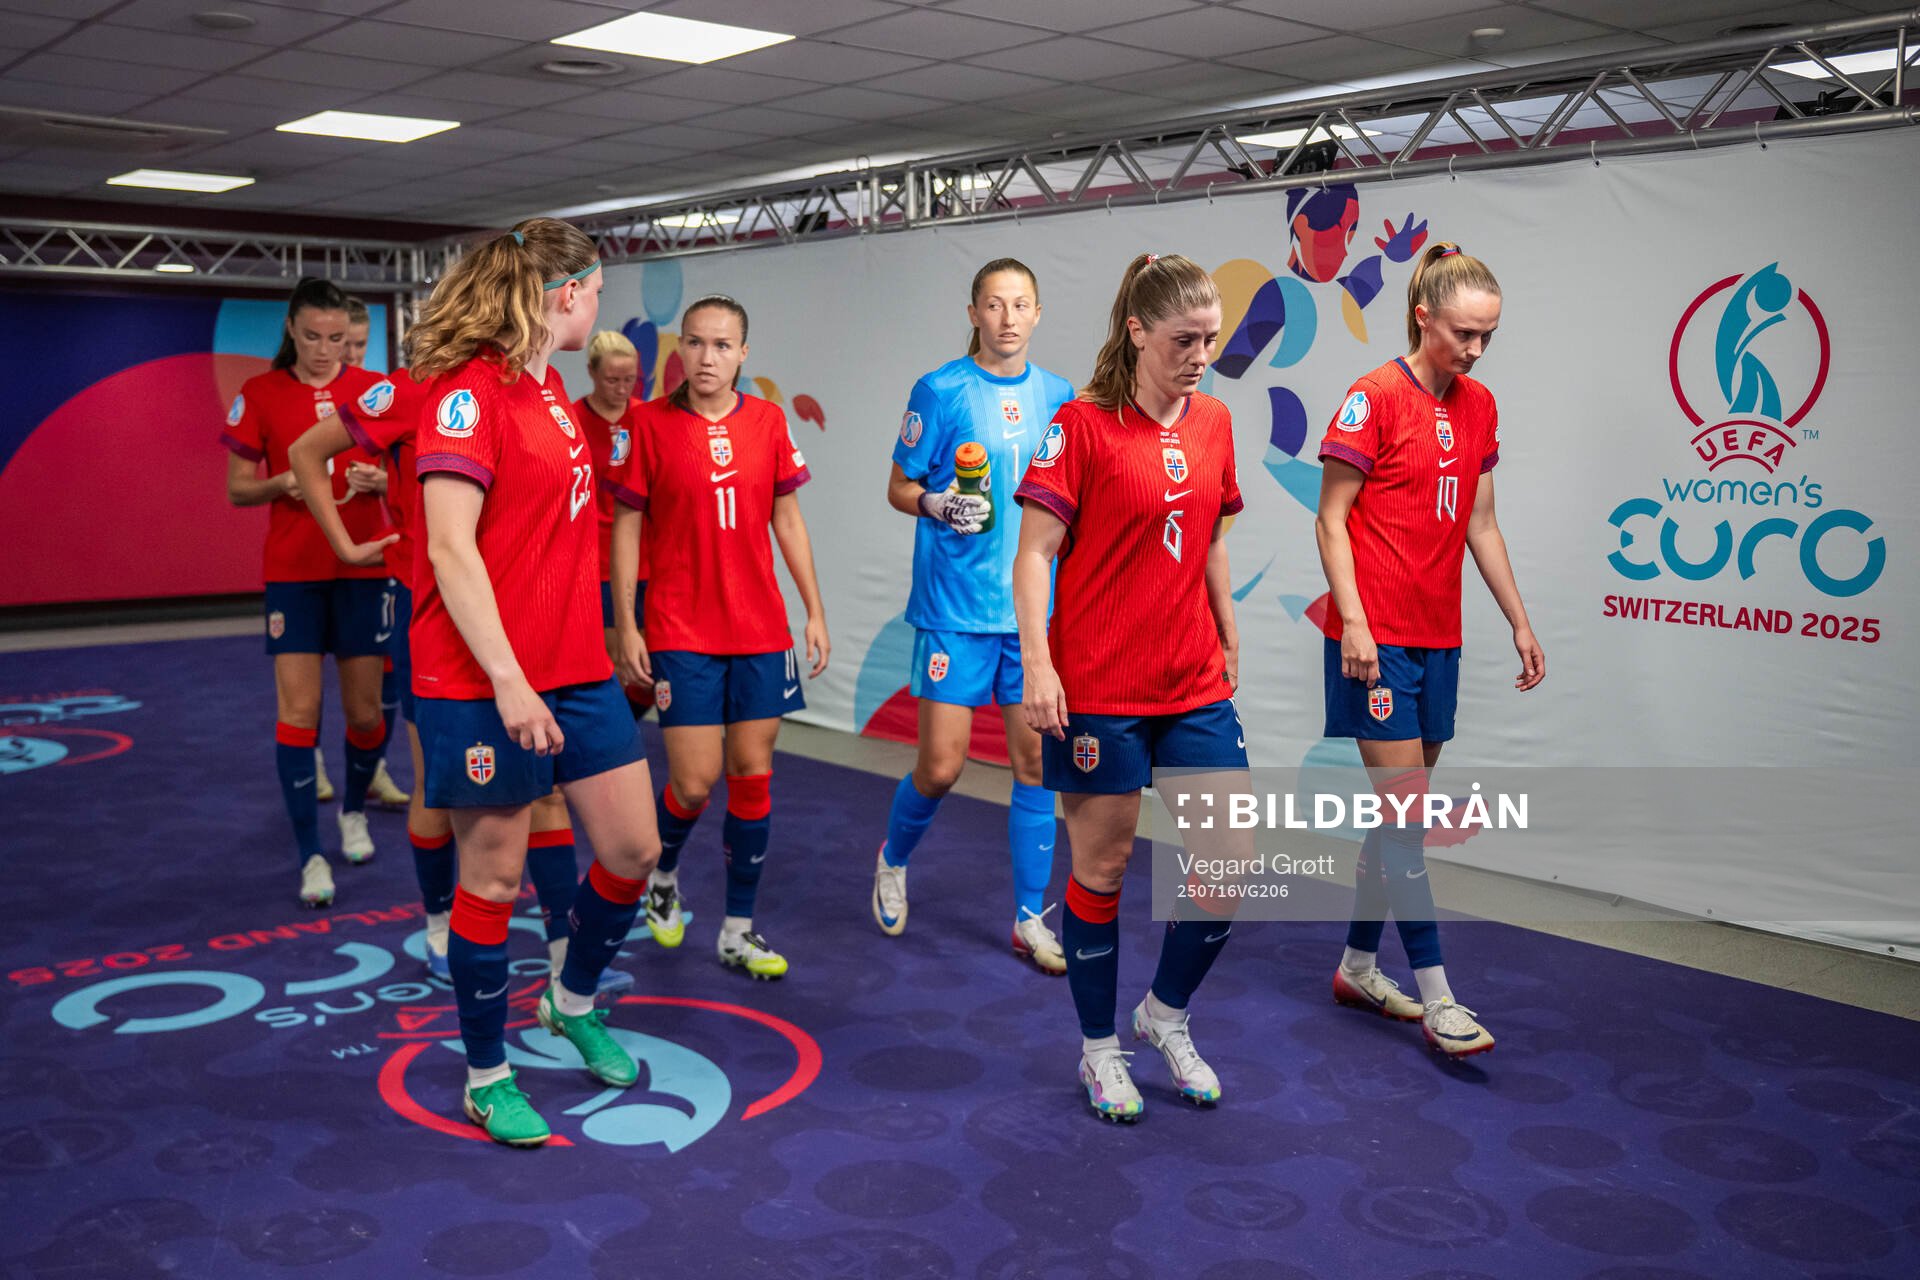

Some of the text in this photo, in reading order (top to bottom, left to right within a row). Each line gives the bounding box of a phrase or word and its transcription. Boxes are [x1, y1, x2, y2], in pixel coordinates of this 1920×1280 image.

[1696, 428, 1785, 467] UEFA
[1802, 429, 1819, 440] TM
[1012, 443, 1019, 484] 1
[714, 486, 736, 530] 11
[1436, 476, 1459, 523] 10
[1663, 475, 1823, 508] women's
[1163, 510, 1184, 564] 6
[1603, 595, 1880, 644] SWITZERLAND 2025
[8, 944, 192, 986] 2025
